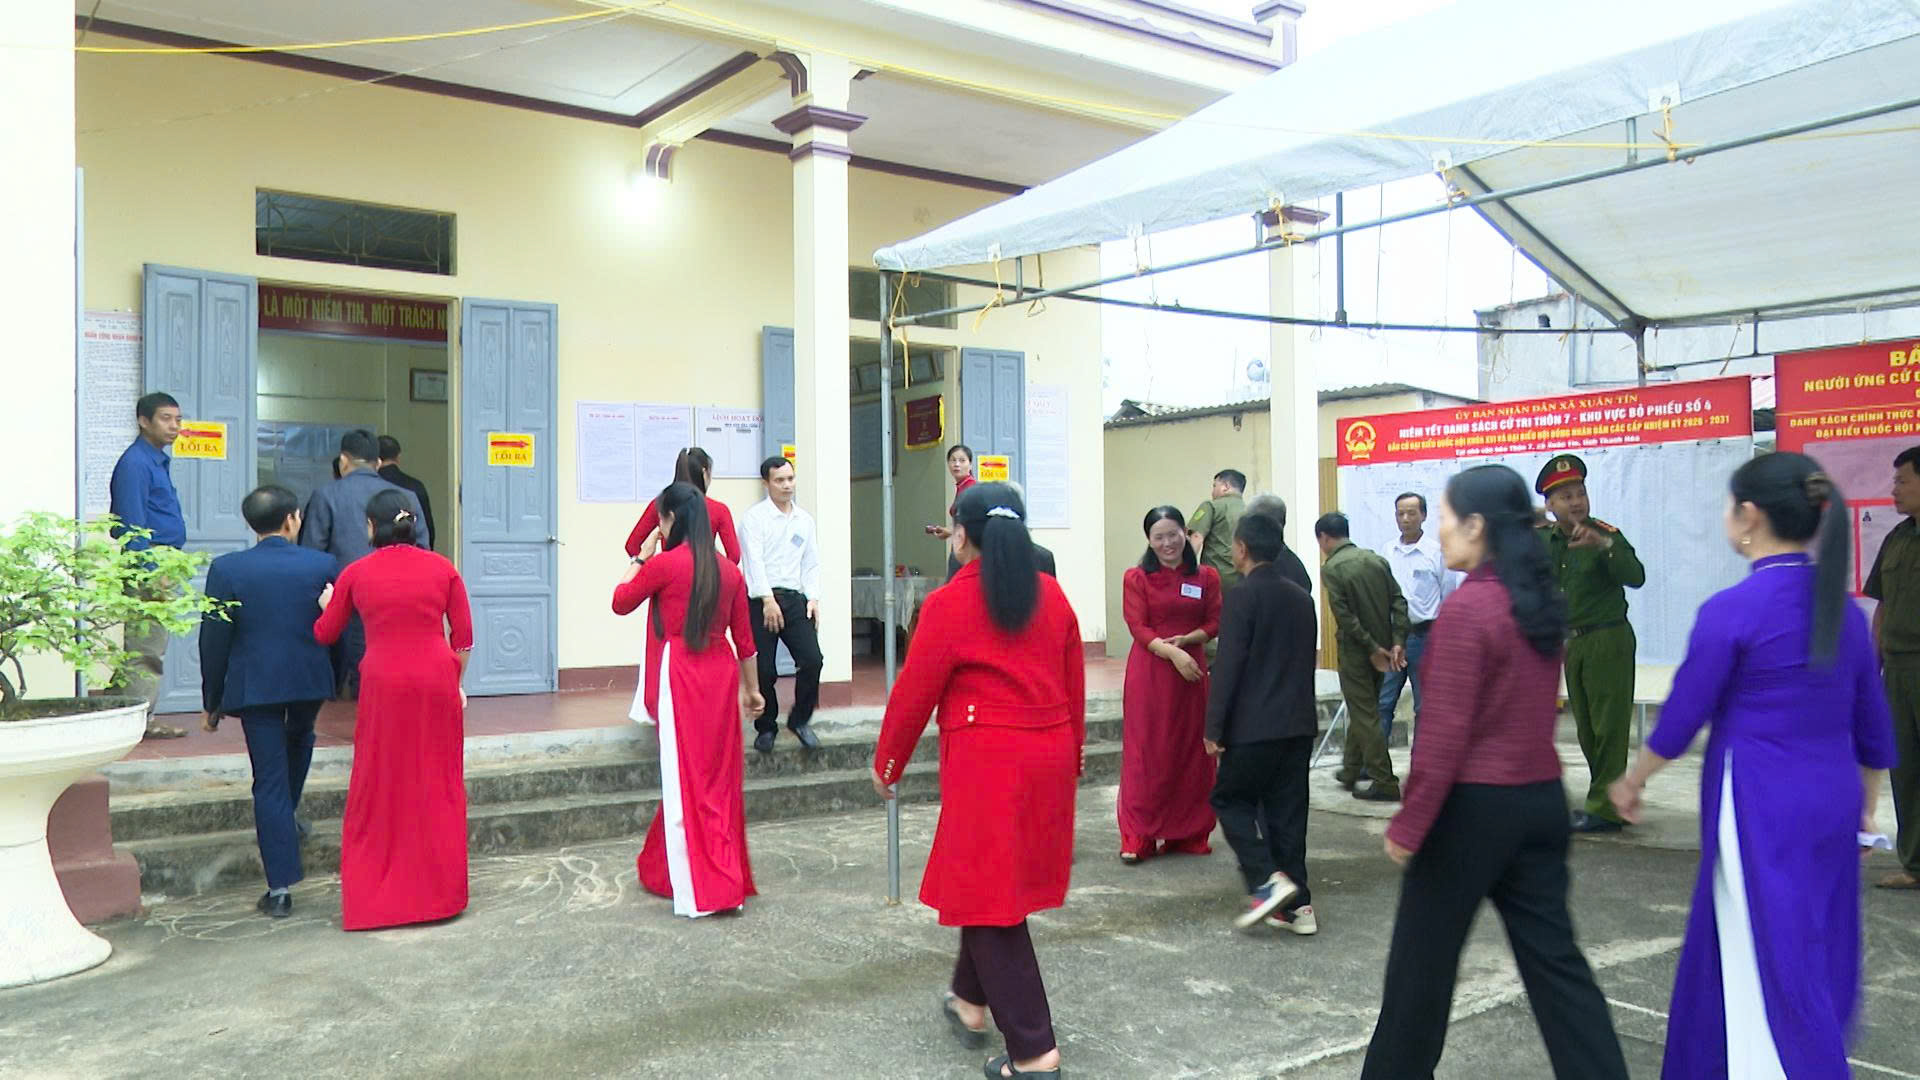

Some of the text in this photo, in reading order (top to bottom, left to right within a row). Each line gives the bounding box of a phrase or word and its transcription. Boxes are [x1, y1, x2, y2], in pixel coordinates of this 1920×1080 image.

[264, 288, 279, 317] LÀ
[282, 291, 308, 324] MỘT
[371, 300, 396, 330] MỘT
[399, 303, 434, 329] TRÁCH
[438, 309, 448, 330] N
[1804, 375, 1850, 392] NGƯỜI
[1854, 373, 1886, 388] ỨNG
[1889, 367, 1912, 384] CỬ
[1399, 425, 1423, 438] NIÊM
[1425, 423, 1441, 436] YẾT
[1443, 423, 1469, 435] DANH
[1471, 420, 1498, 432] SÁCH
[1500, 417, 1514, 430] CỬ
[1516, 417, 1532, 428] TRI
[1534, 413, 1561, 426] THÔN
[1563, 413, 1571, 424] 7
[1579, 411, 1602, 423] KHU
[1604, 408, 1626, 422] VỰC
[1629, 403, 1644, 418] BỎ
[1647, 400, 1682, 416] PHIẾU
[1685, 398, 1701, 412] SỐ
[1455, 409, 1469, 420] ỦY
[1473, 409, 1495, 418] BAN
[1498, 405, 1529, 415] NHÂN
[1532, 401, 1556, 412] DÂN
[1560, 399, 1575, 409] XÃ
[1579, 395, 1613, 408] XUÂN
[1710, 415, 1729, 425] 2031
[1790, 416, 1818, 428] DANH
[1820, 413, 1848, 425] SÁCH
[1849, 410, 1884, 422] CHÍNH
[1815, 428, 1833, 439] ĐẠI
